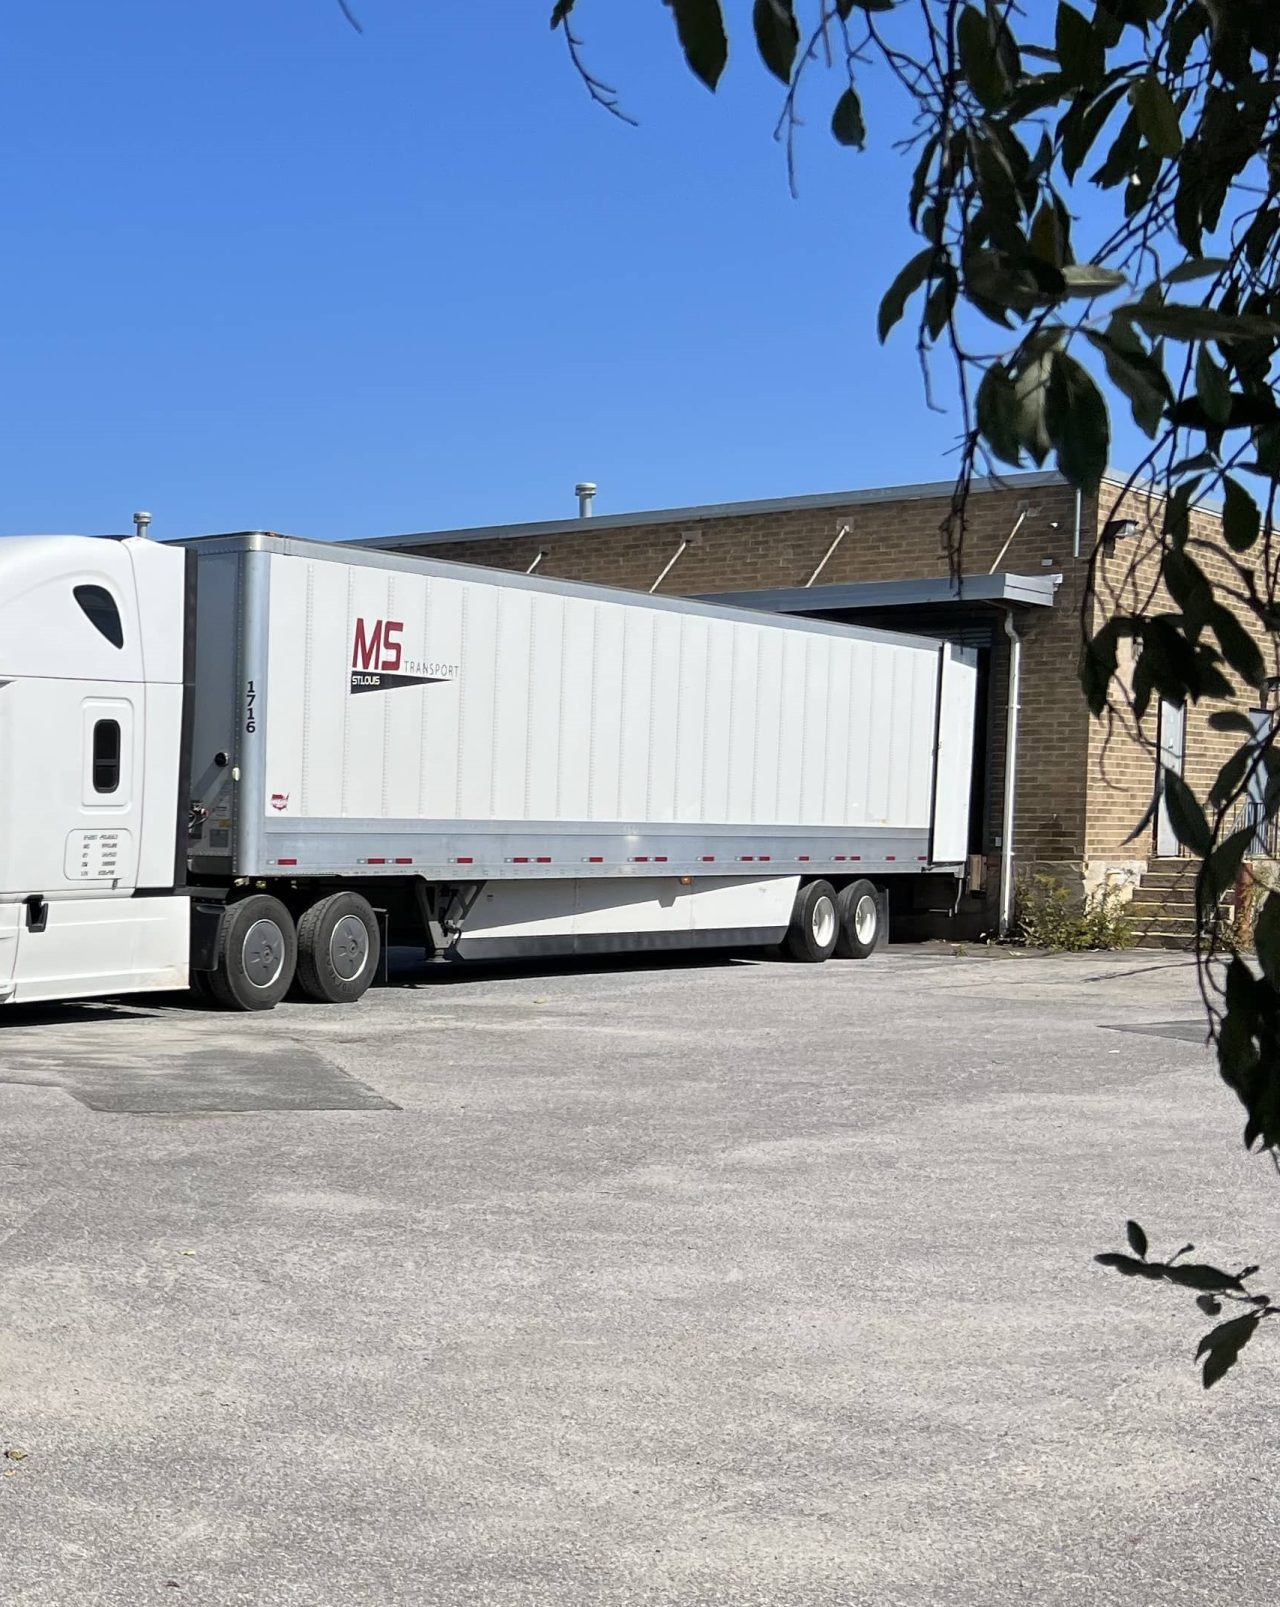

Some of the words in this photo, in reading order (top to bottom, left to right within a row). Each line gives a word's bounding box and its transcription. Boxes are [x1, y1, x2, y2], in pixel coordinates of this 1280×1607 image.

[351, 617, 404, 671] MS
[404, 661, 460, 678] TRANSPORT
[245, 680, 256, 733] 1716
